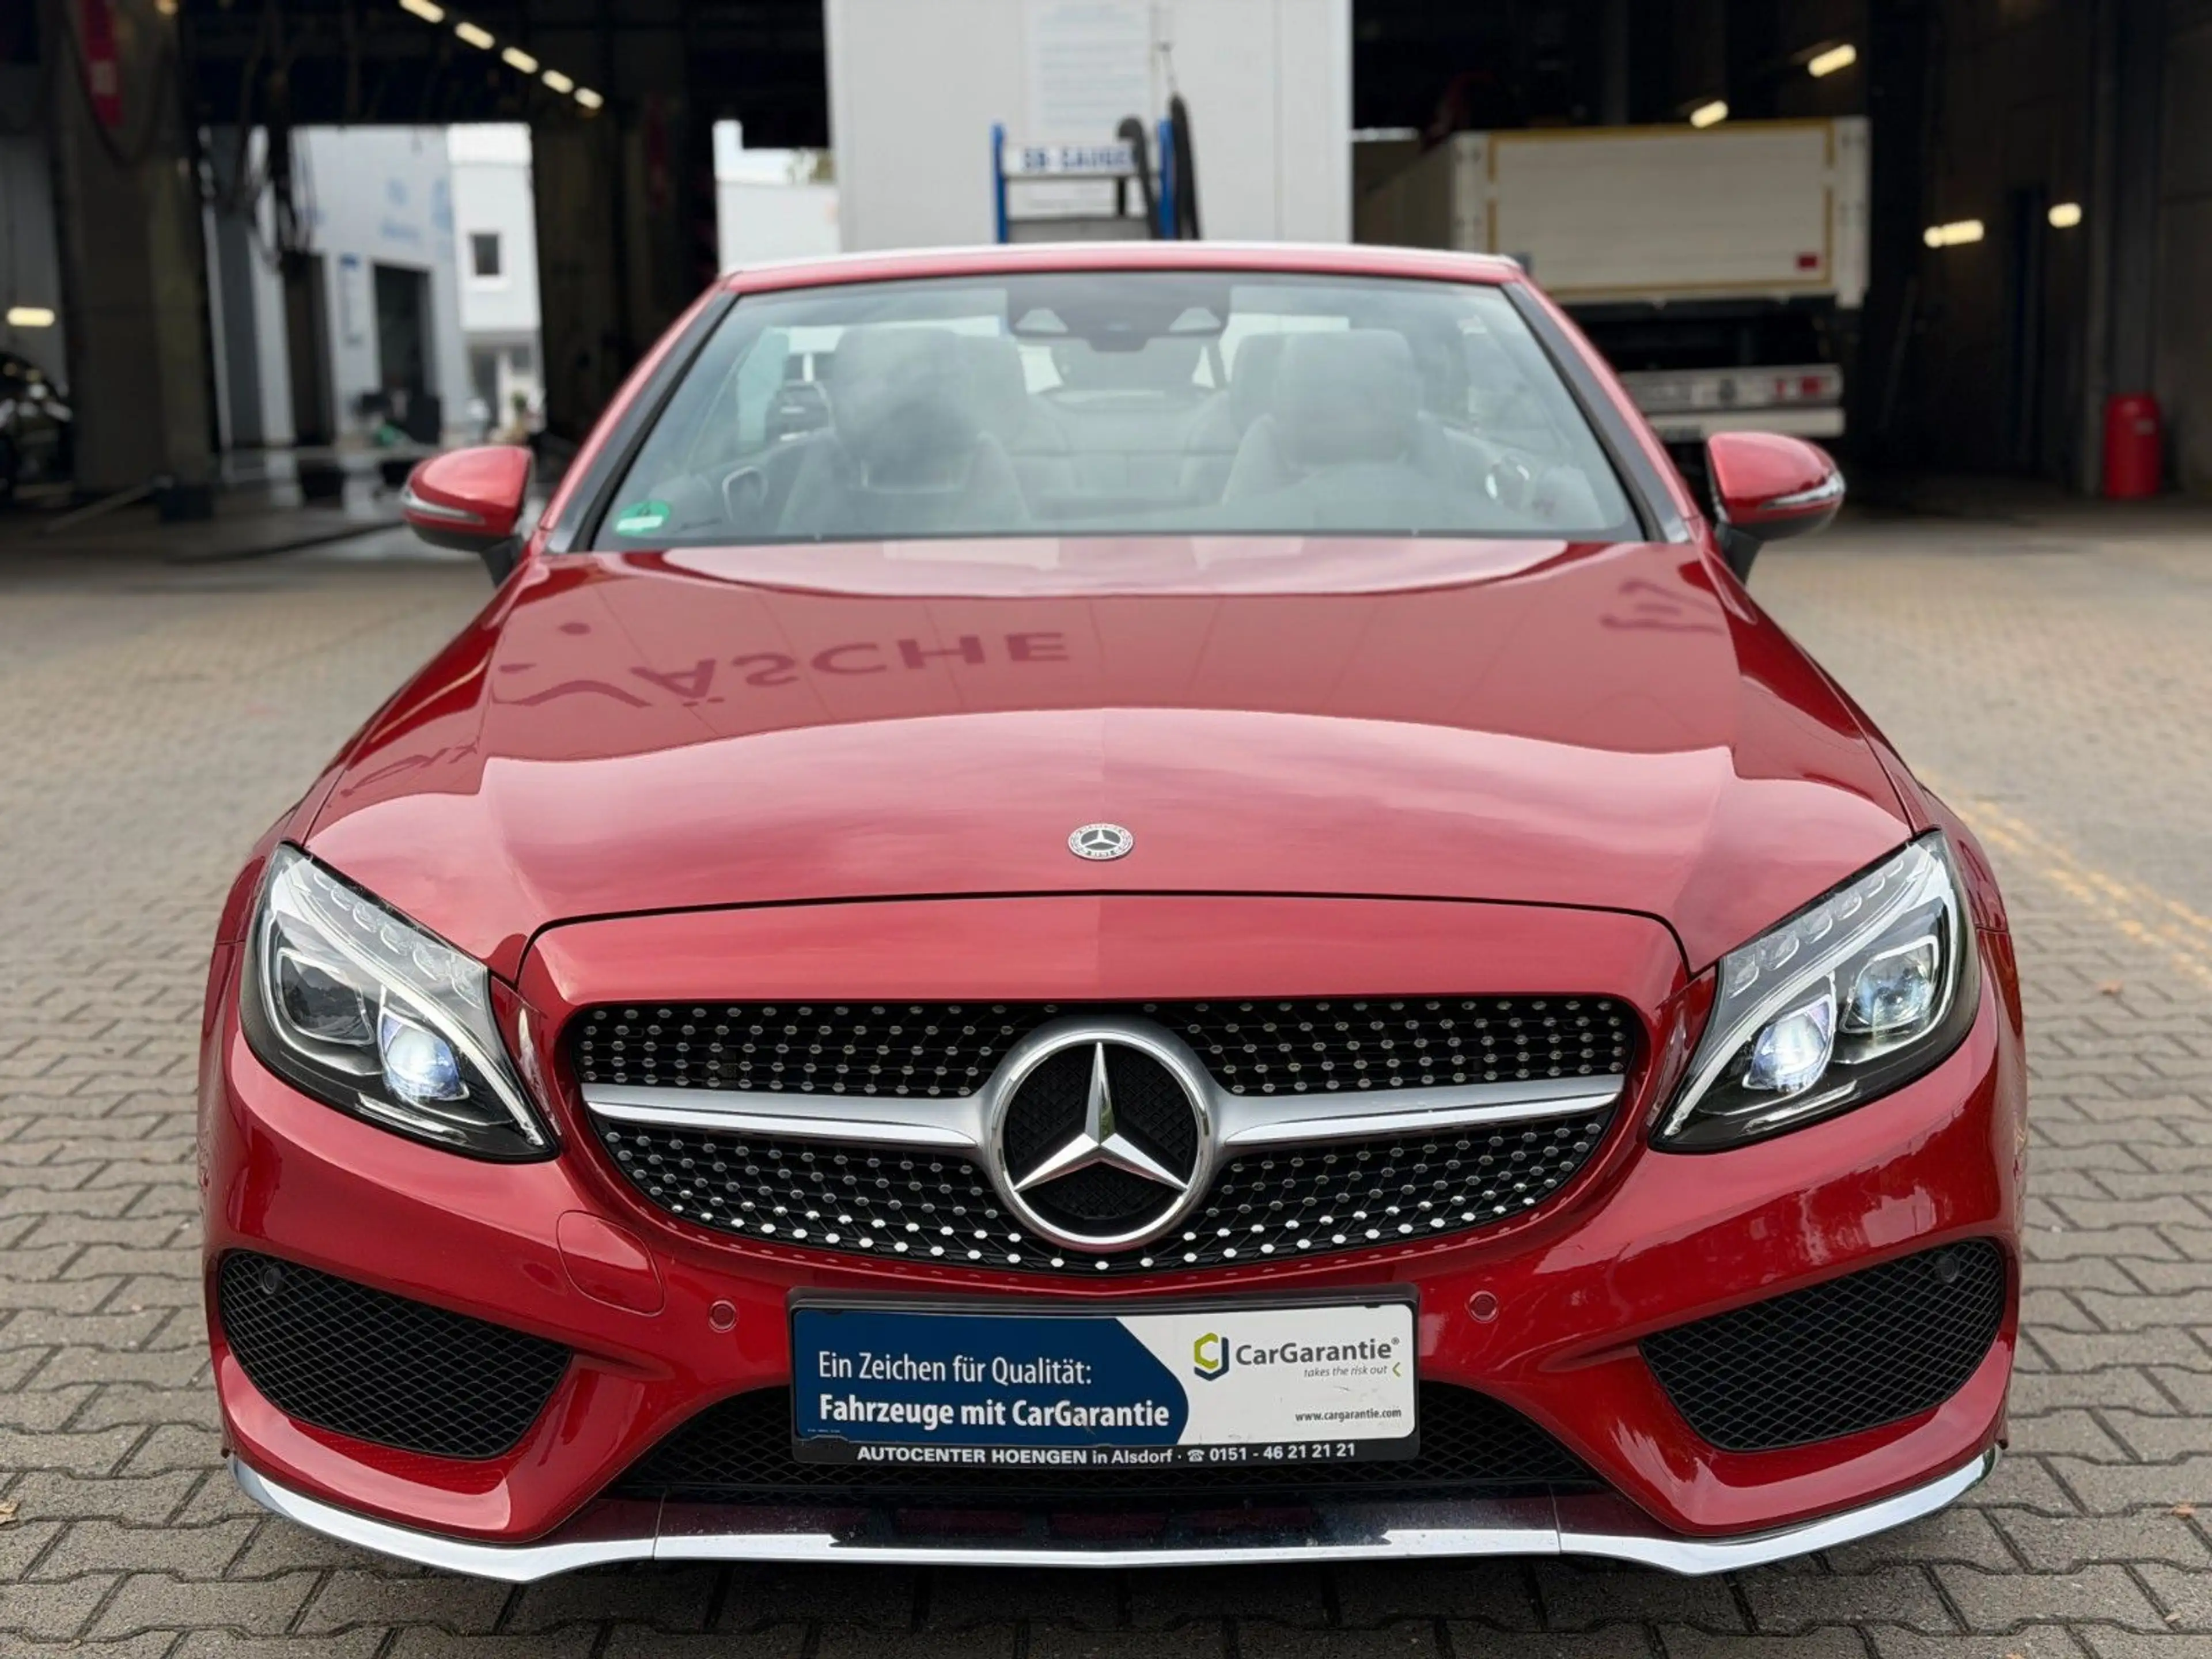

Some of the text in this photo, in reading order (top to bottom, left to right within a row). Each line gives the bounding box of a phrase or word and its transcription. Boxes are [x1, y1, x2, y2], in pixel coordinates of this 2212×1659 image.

[819, 1351, 1092, 1386] Ein Zeichen für Qualität:
[1304, 1365, 1388, 1378] takes the risk out
[820, 1393, 1169, 1430] Fahrzeuge mit CarGarantie
[1295, 1408, 1402, 1423] www.cargarantie.com
[857, 1446, 986, 1463] AUTOCENTER
[992, 1449, 1087, 1464] HOENGEN
[1093, 1449, 1108, 1464] in
[1111, 1449, 1173, 1464] Alsdorf
[1210, 1446, 1248, 1461] 0151
[1263, 1445, 1283, 1460] 46
[1287, 1444, 1307, 1459] 21
[1312, 1443, 1331, 1457] 21
[1336, 1442, 1355, 1457] 21
